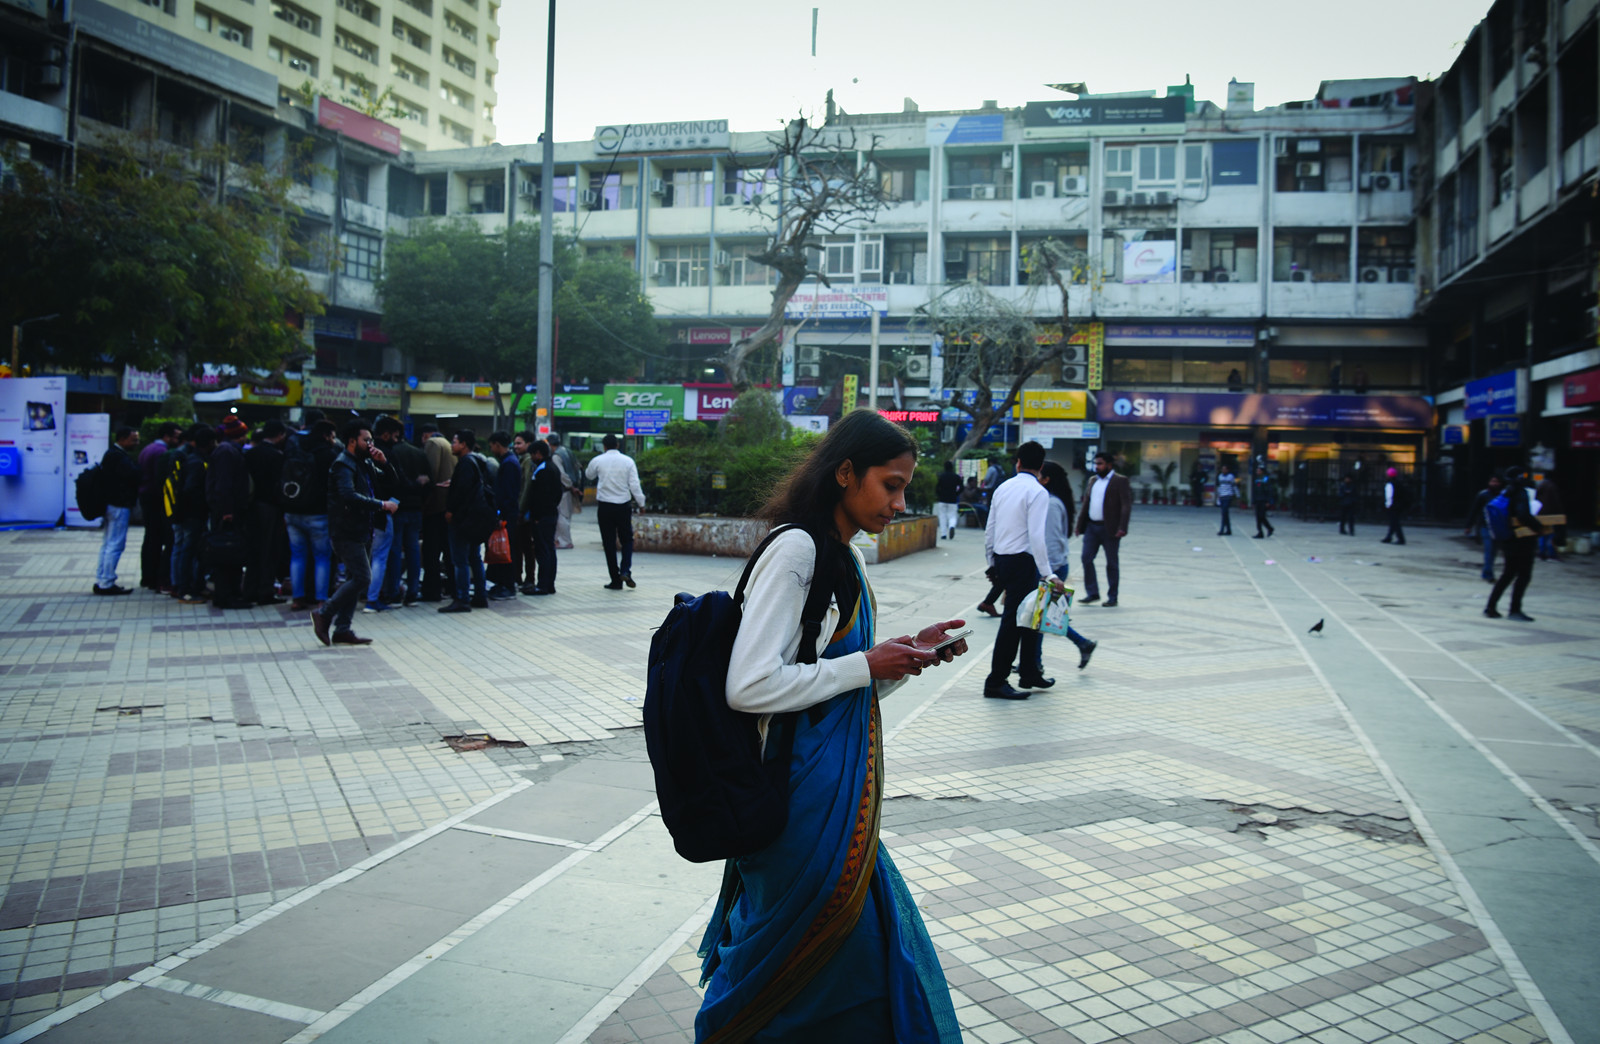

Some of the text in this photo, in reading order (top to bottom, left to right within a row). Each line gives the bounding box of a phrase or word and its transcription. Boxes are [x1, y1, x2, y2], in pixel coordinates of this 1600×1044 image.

[693, 330, 728, 340] Lenovo
[323, 378, 349, 388] NEW
[311, 387, 360, 399] PUNJABI
[315, 398, 355, 408] KHANA
[614, 391, 663, 407] acer
[1026, 396, 1072, 410] realme
[1132, 398, 1164, 417] SBI
[909, 411, 939, 422] PRINT
